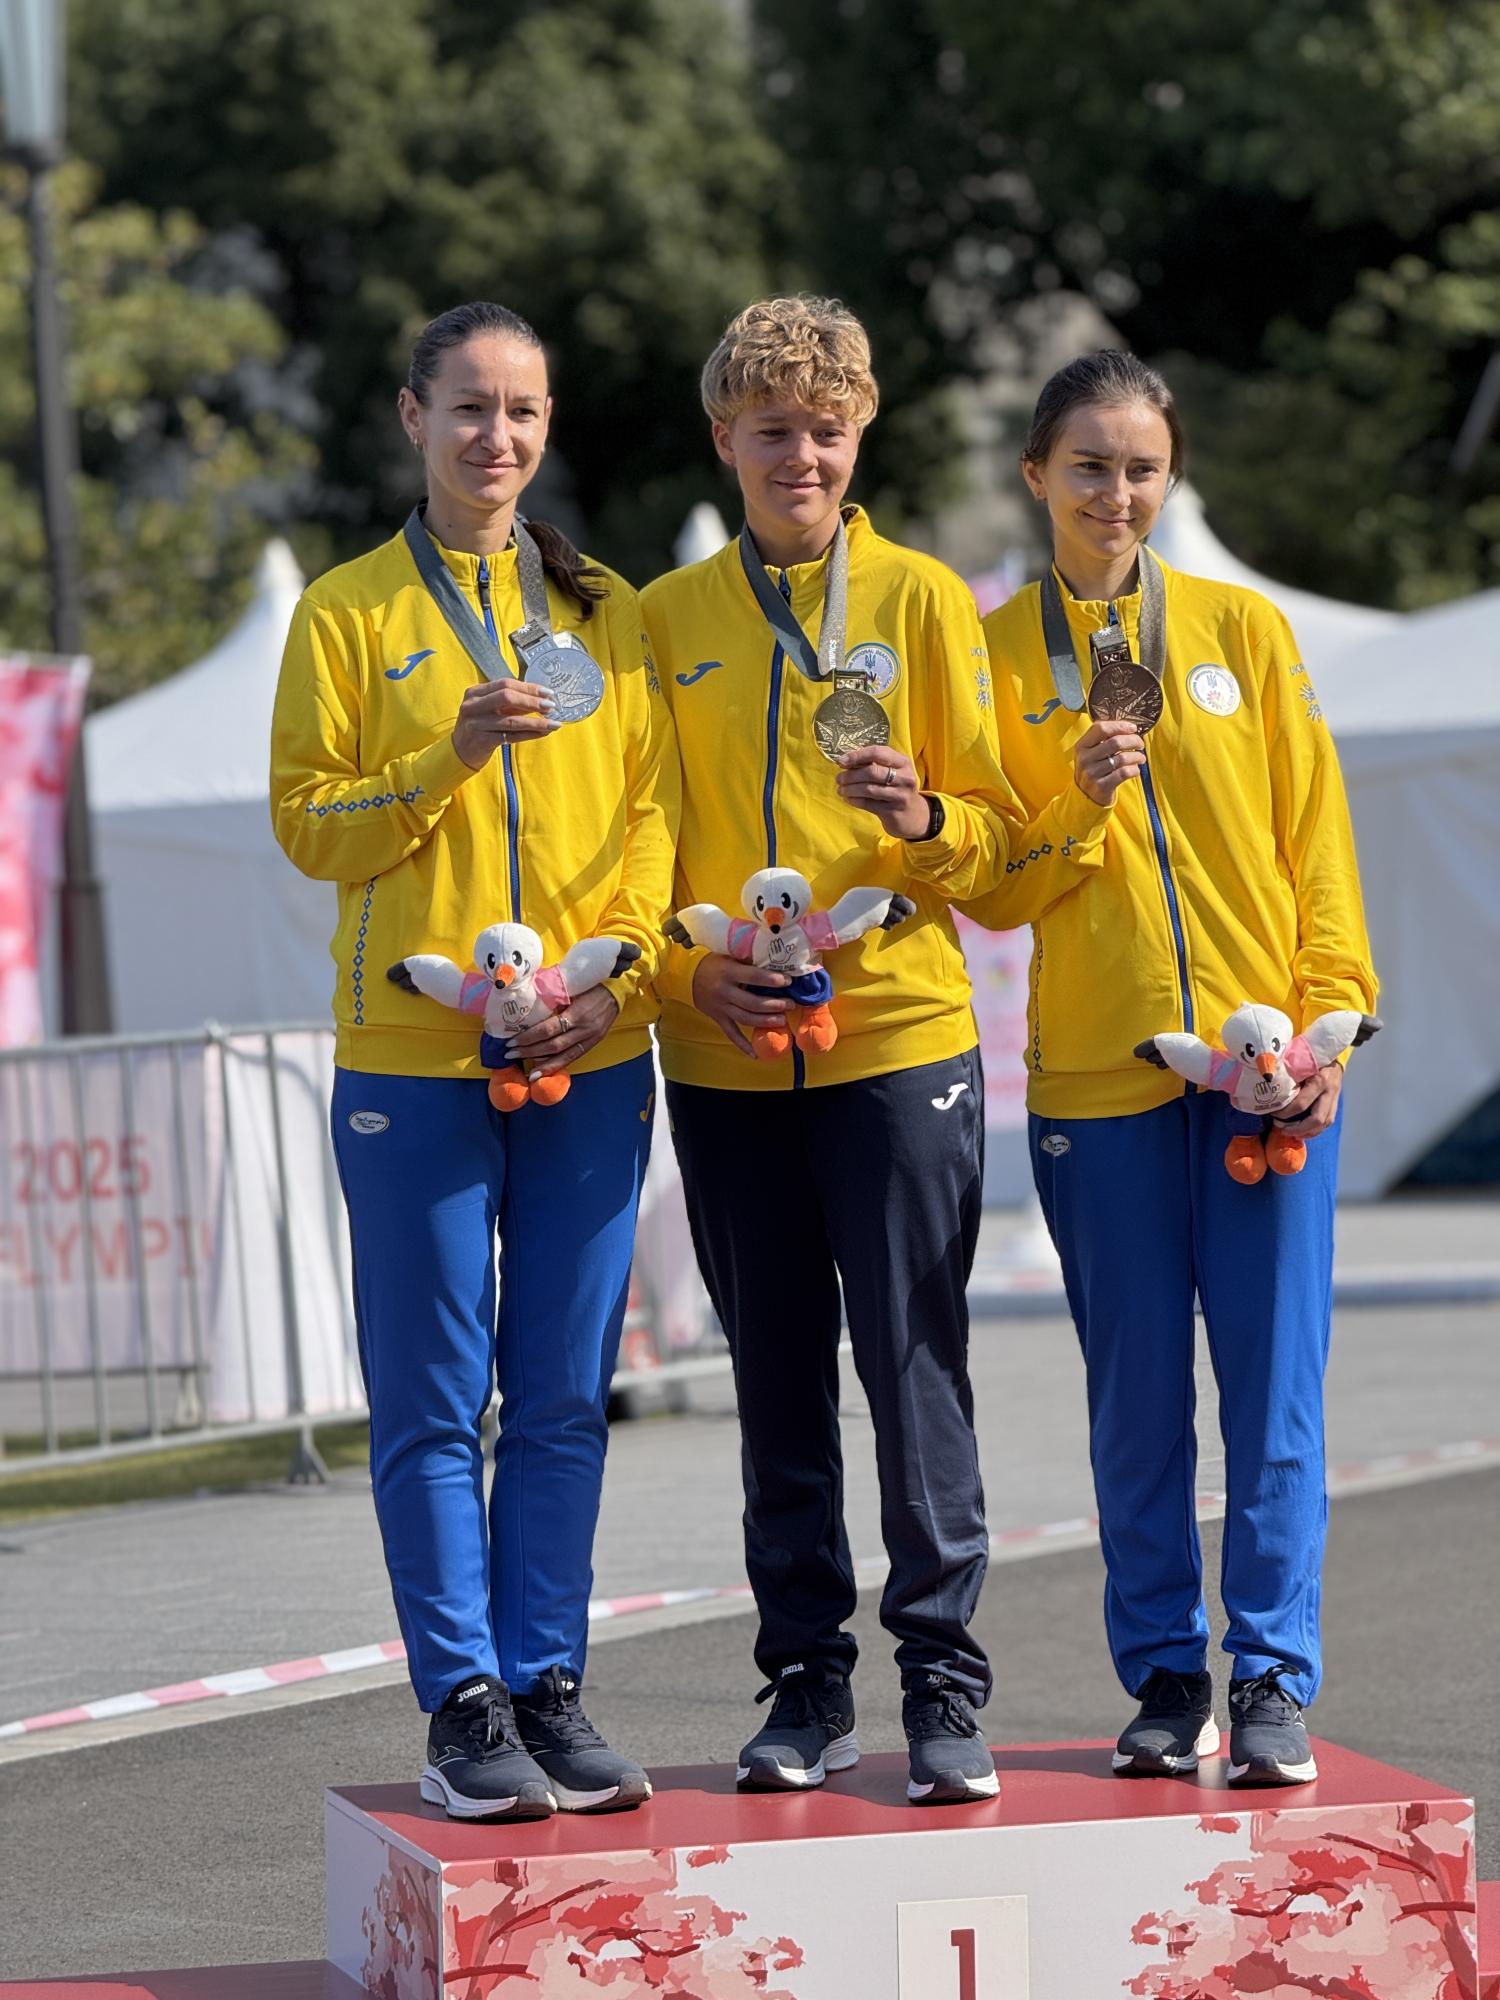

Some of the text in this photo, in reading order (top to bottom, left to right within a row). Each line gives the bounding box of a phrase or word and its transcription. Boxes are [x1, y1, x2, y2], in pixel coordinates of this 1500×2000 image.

[14, 1133, 151, 1204] 2025
[457, 1682, 488, 1702] Joma
[951, 1928, 976, 2000] 1
